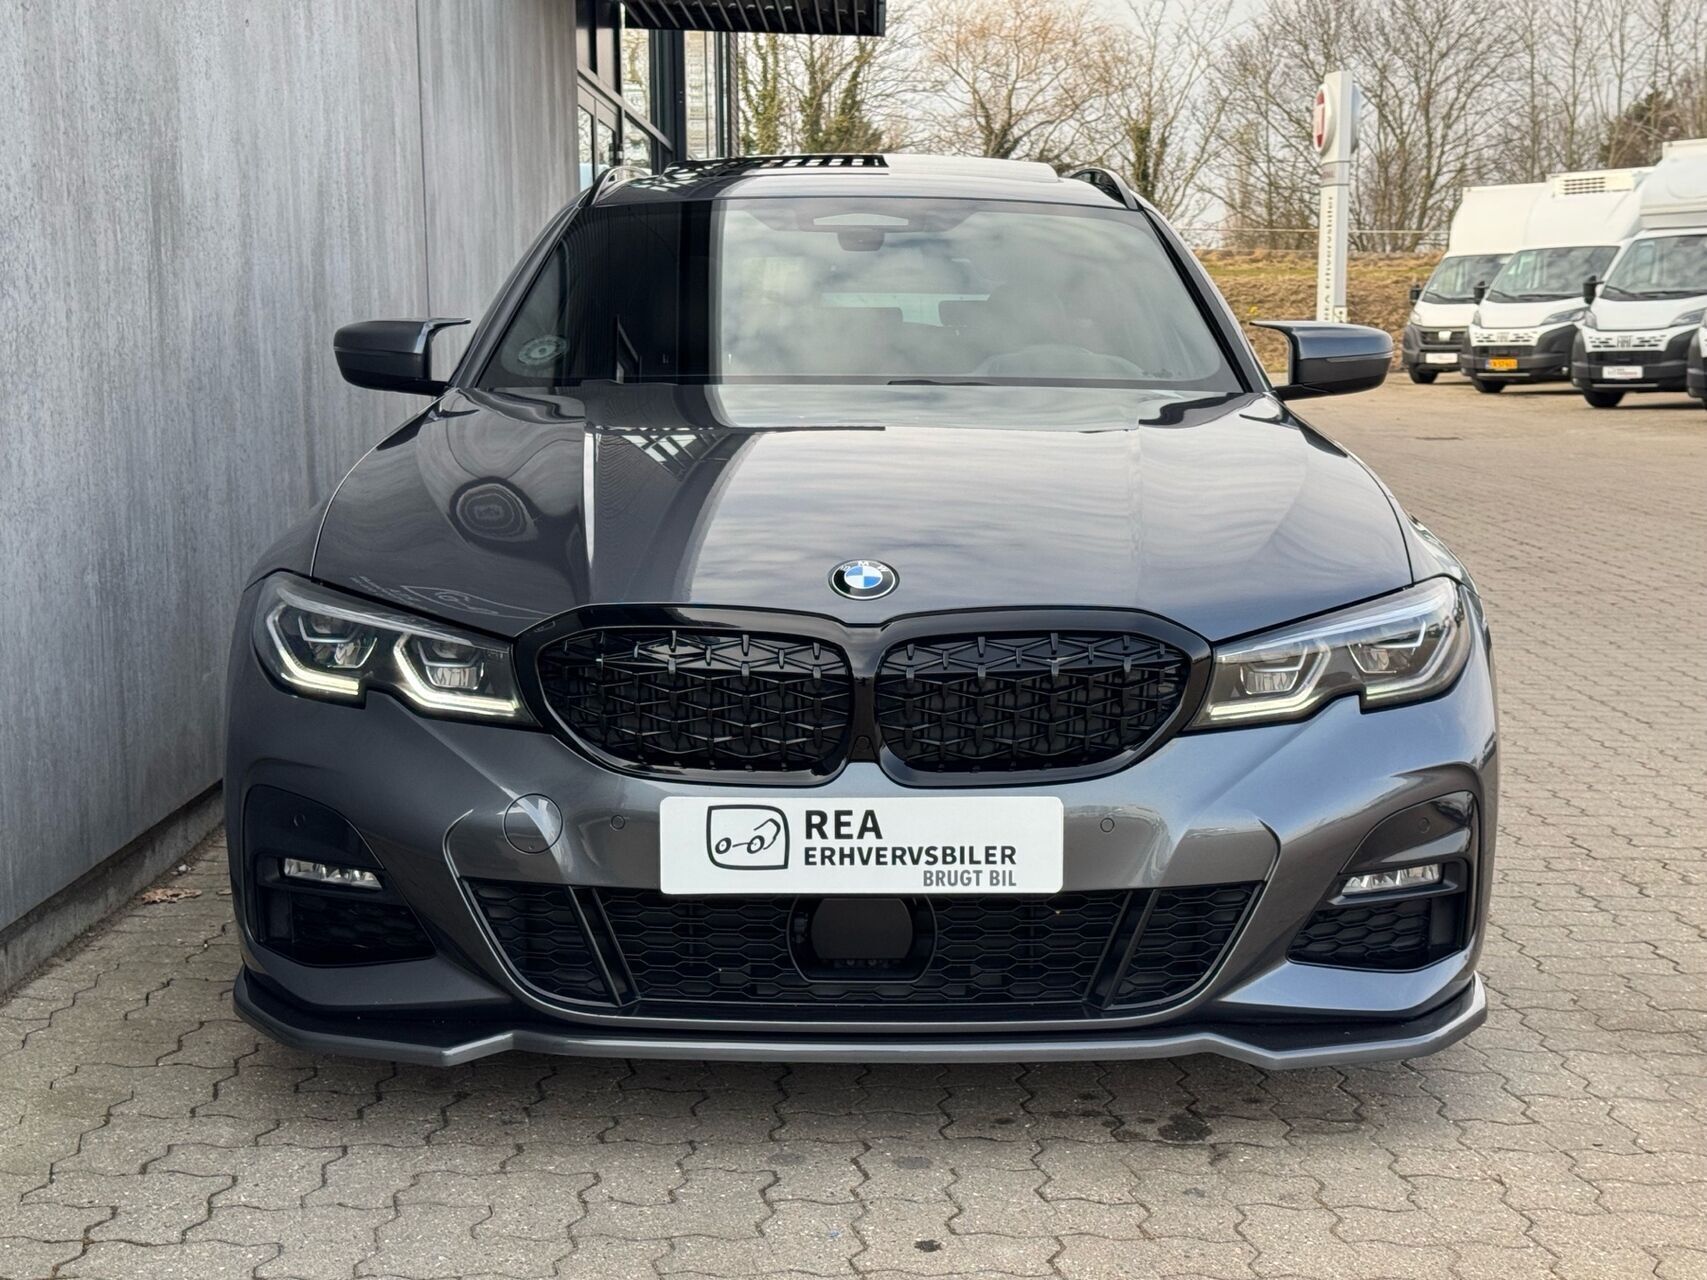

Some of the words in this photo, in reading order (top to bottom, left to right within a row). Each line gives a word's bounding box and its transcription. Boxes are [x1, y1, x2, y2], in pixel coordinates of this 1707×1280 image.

[840, 560, 889, 572] BMW
[805, 810, 883, 840] REA
[804, 846, 1017, 866] ERHVERVSBILER
[923, 870, 983, 887] BRUGT
[989, 870, 1017, 887] BIL
